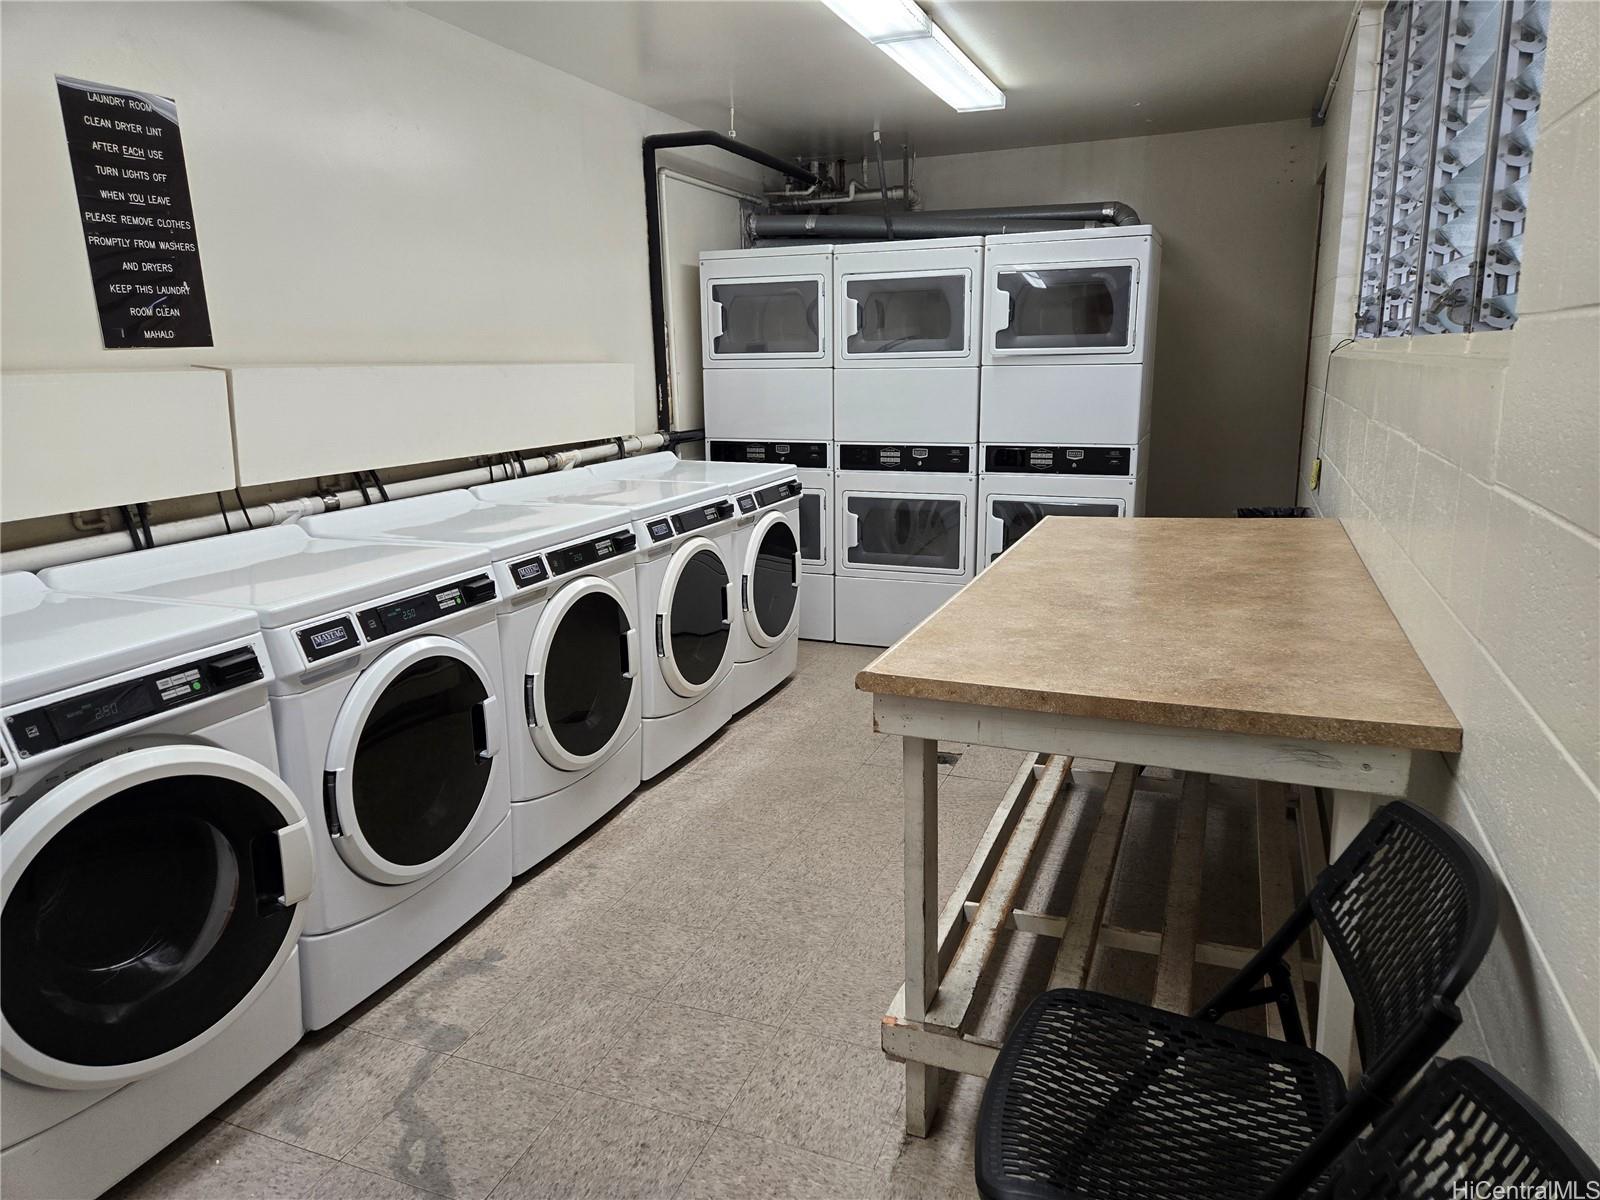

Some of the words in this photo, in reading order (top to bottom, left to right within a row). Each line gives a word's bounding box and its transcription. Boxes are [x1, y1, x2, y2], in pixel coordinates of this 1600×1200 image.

[87, 92, 125, 107] LAUNDRY
[129, 100, 153, 112] ROOM
[84, 115, 112, 129] CLEAN
[115, 120, 143, 134] DRYER
[145, 126, 163, 137] LINT
[92, 141, 119, 153] AFTER
[123, 145, 146, 158] EACH
[147, 150, 164, 160] USE
[95, 164, 119, 177] TURN
[121, 169, 150, 181] LIGHTS
[153, 173, 168, 183] OFF
[100, 189, 125, 201] WHEN
[127, 192, 146, 203] YOU
[147, 195, 172, 206] LEAVE
[85, 211, 118, 224] PLEASE
[120, 215, 154, 227] REMOVE
[156, 218, 191, 230] CLOTHES
[88, 235, 131, 248] PROMPTLY
[133, 239, 156, 249] FROM
[158, 241, 196, 252] WASHERS
[122, 261, 139, 271] AND
[142, 262, 174, 273] DRYERS
[109, 283, 132, 294] KEEP
[134, 284, 154, 294] THIS
[156, 286, 190, 295] LAUNDRY
[129, 307, 153, 316] ROOM
[155, 307, 180, 317] CLEAN
[143, 329, 175, 339] MAHALO
[314, 628, 344, 643] MAYTAG
